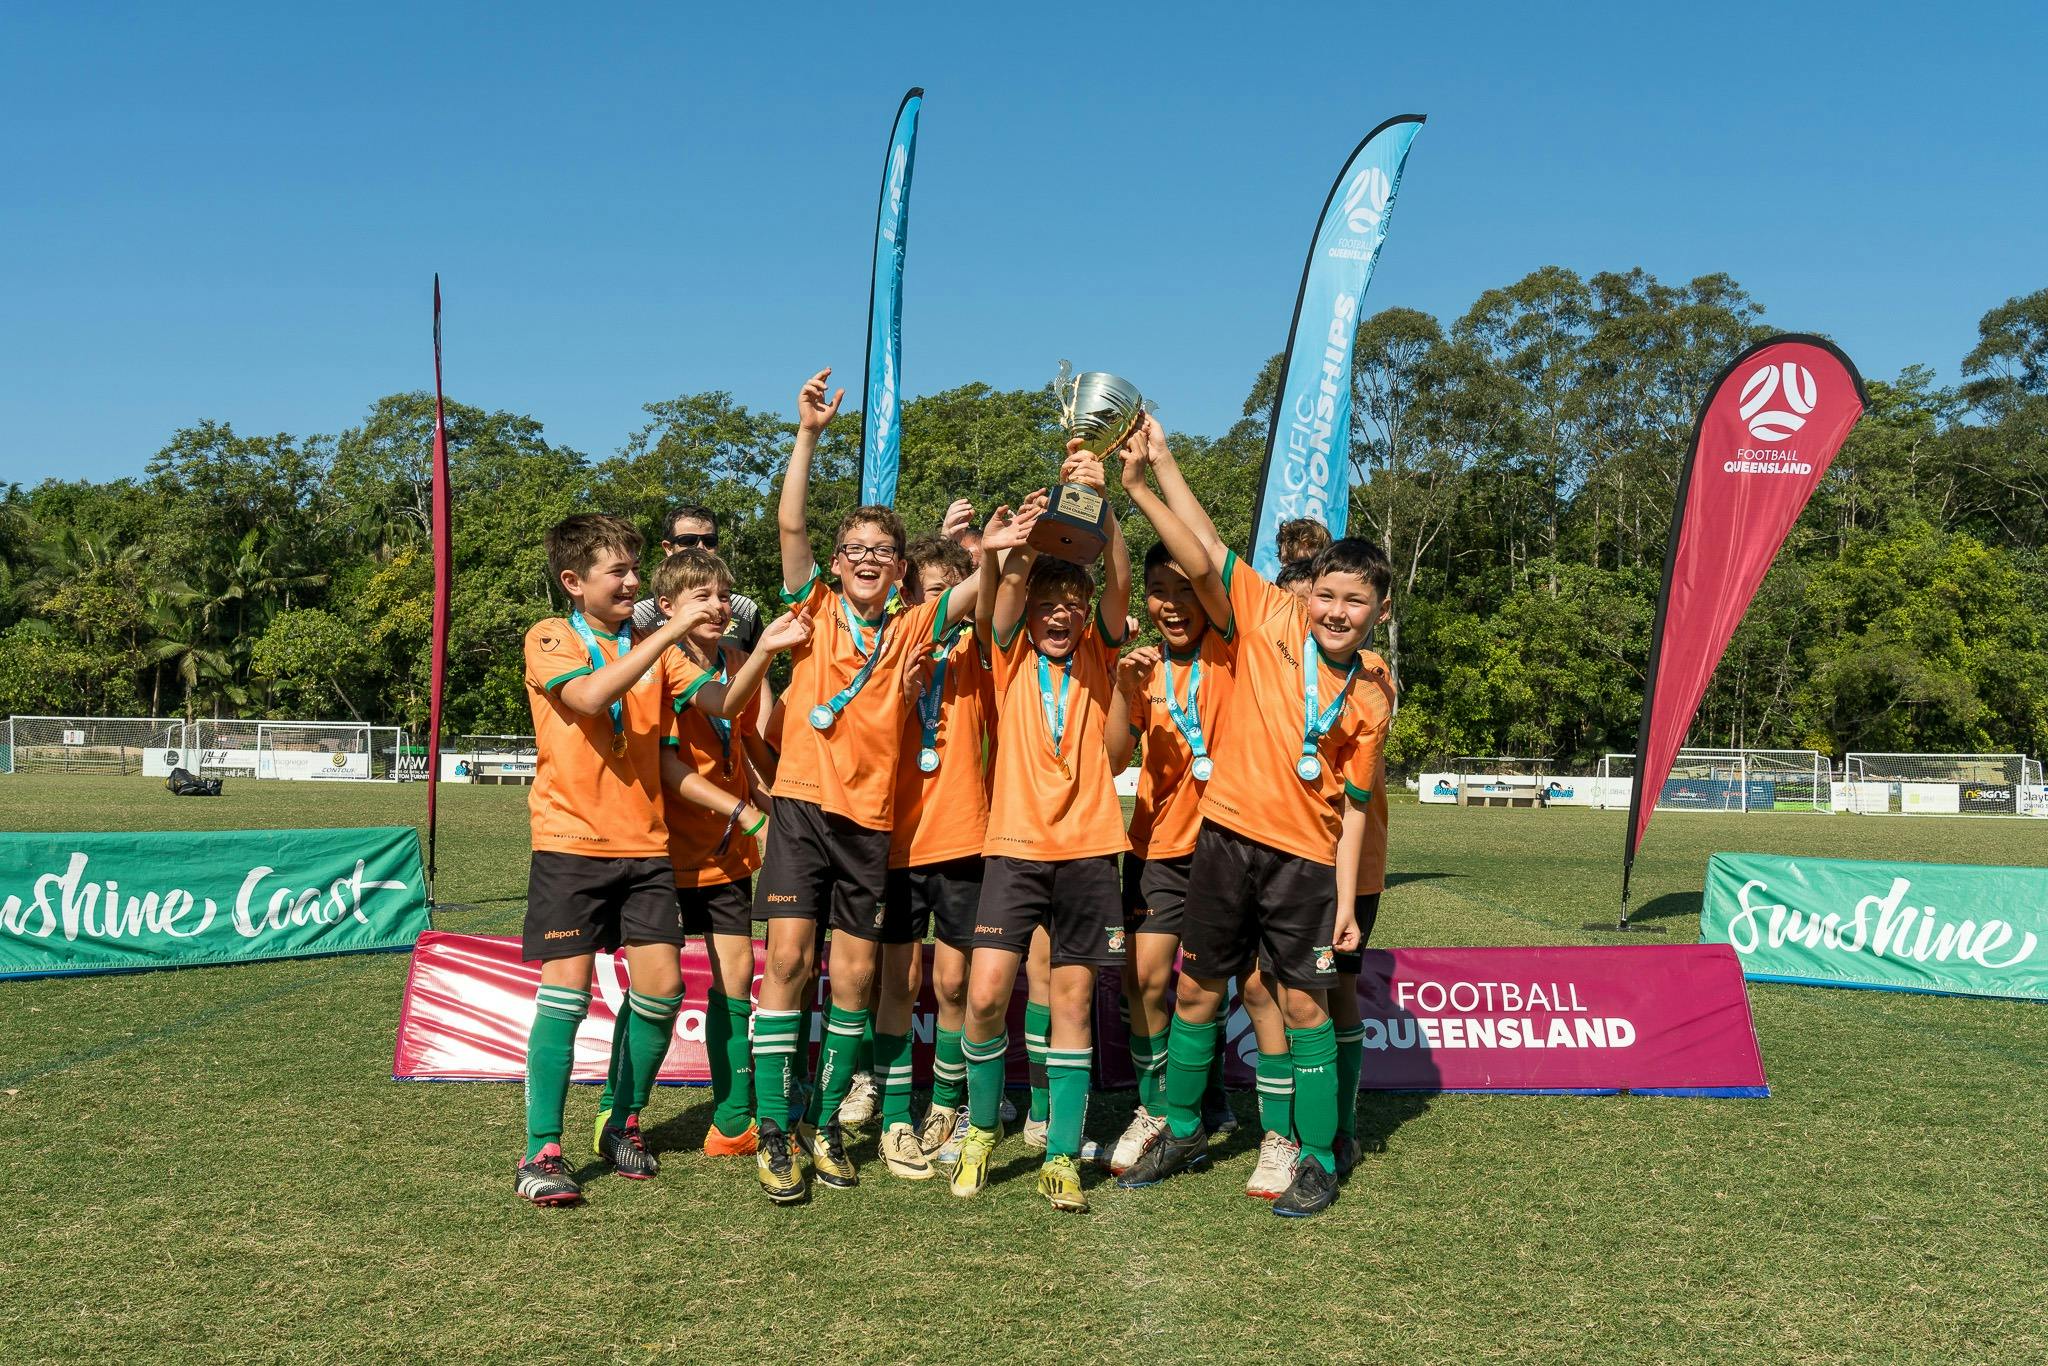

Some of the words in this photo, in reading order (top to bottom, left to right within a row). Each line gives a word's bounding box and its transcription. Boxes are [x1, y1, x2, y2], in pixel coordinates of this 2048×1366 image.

[1328, 247, 1372, 261] QUEENSLAN
[1723, 460, 1812, 475] QUEENSLAND
[1737, 448, 1798, 461] FOOTBALL
[1275, 639, 1300, 670] uhlsport
[231, 858, 408, 939] Coast
[544, 928, 581, 940] uhlsport
[1728, 878, 2038, 969] Sunshine
[1397, 981, 1588, 1012] FOOTBALL
[1361, 1017, 1637, 1051] QUEENSLAND
